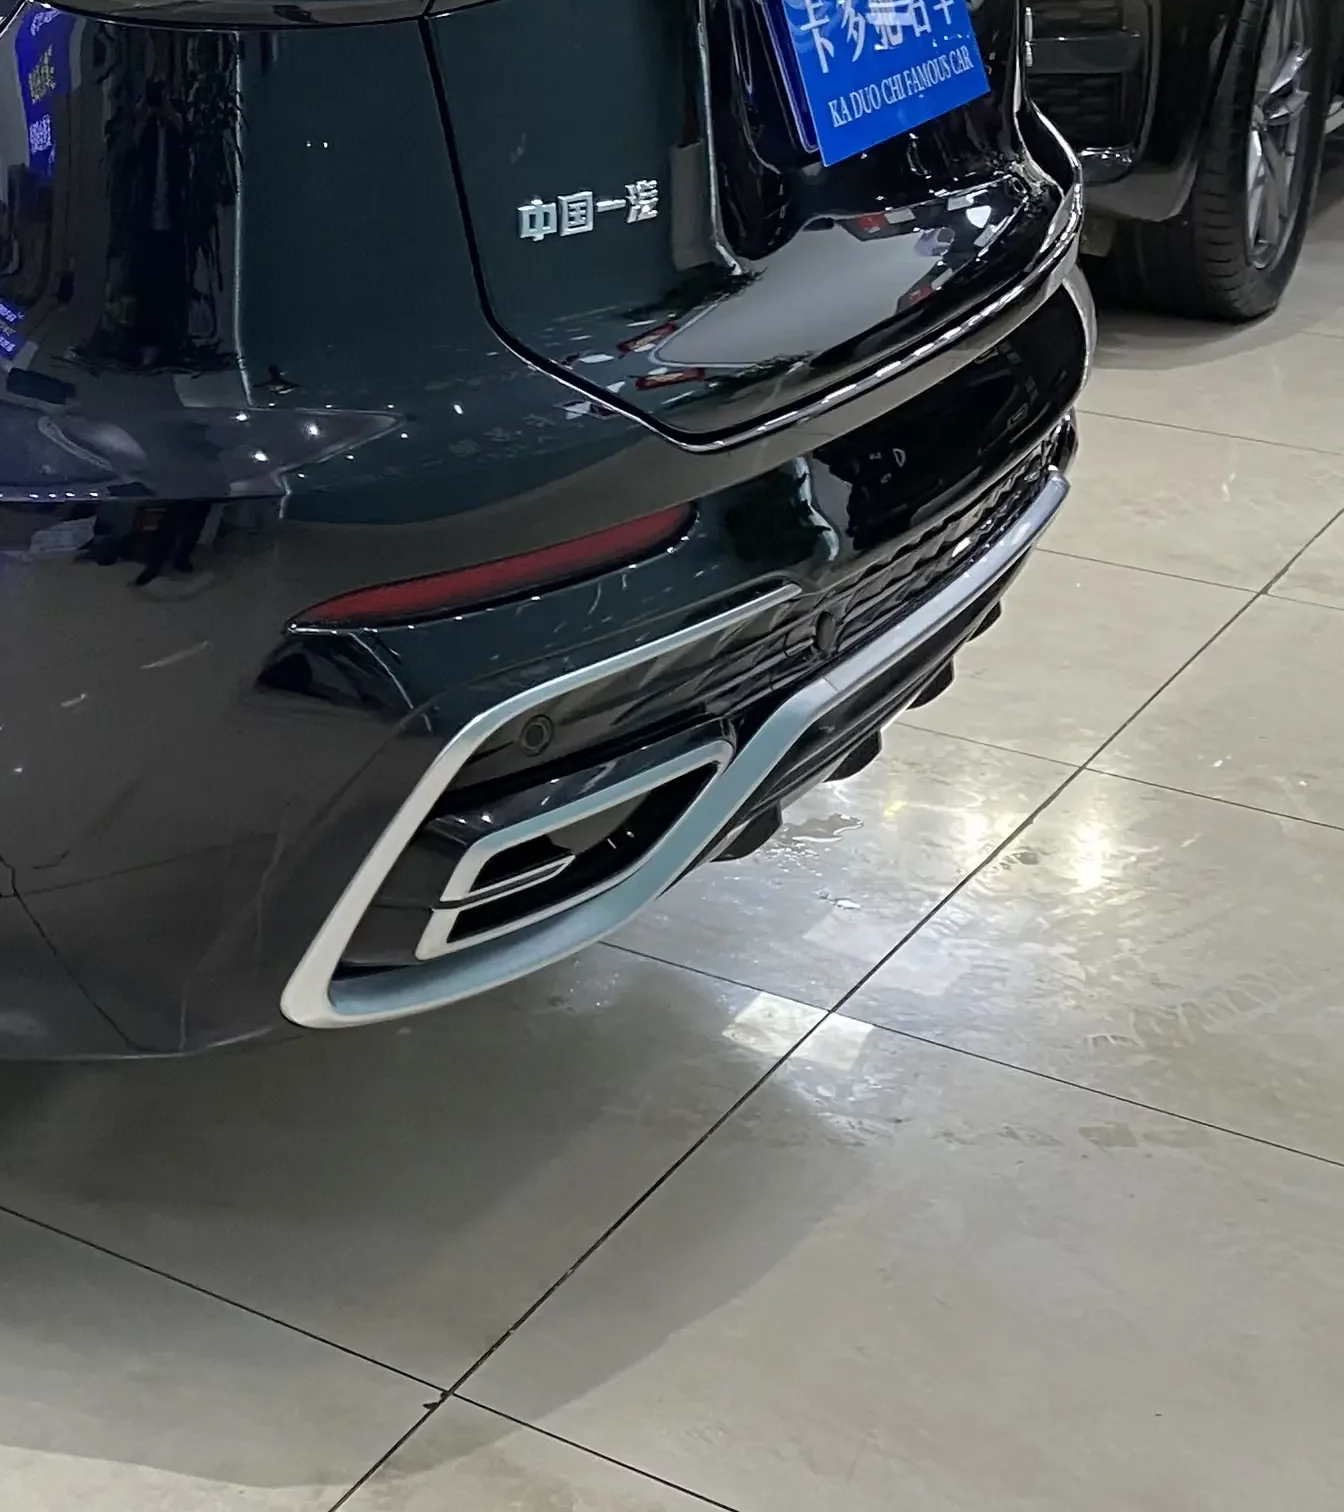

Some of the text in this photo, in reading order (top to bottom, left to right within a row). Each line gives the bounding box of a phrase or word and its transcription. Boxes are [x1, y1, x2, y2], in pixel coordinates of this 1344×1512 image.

[828, 45, 974, 128] KA DUO CHI FAMOUS CAR
